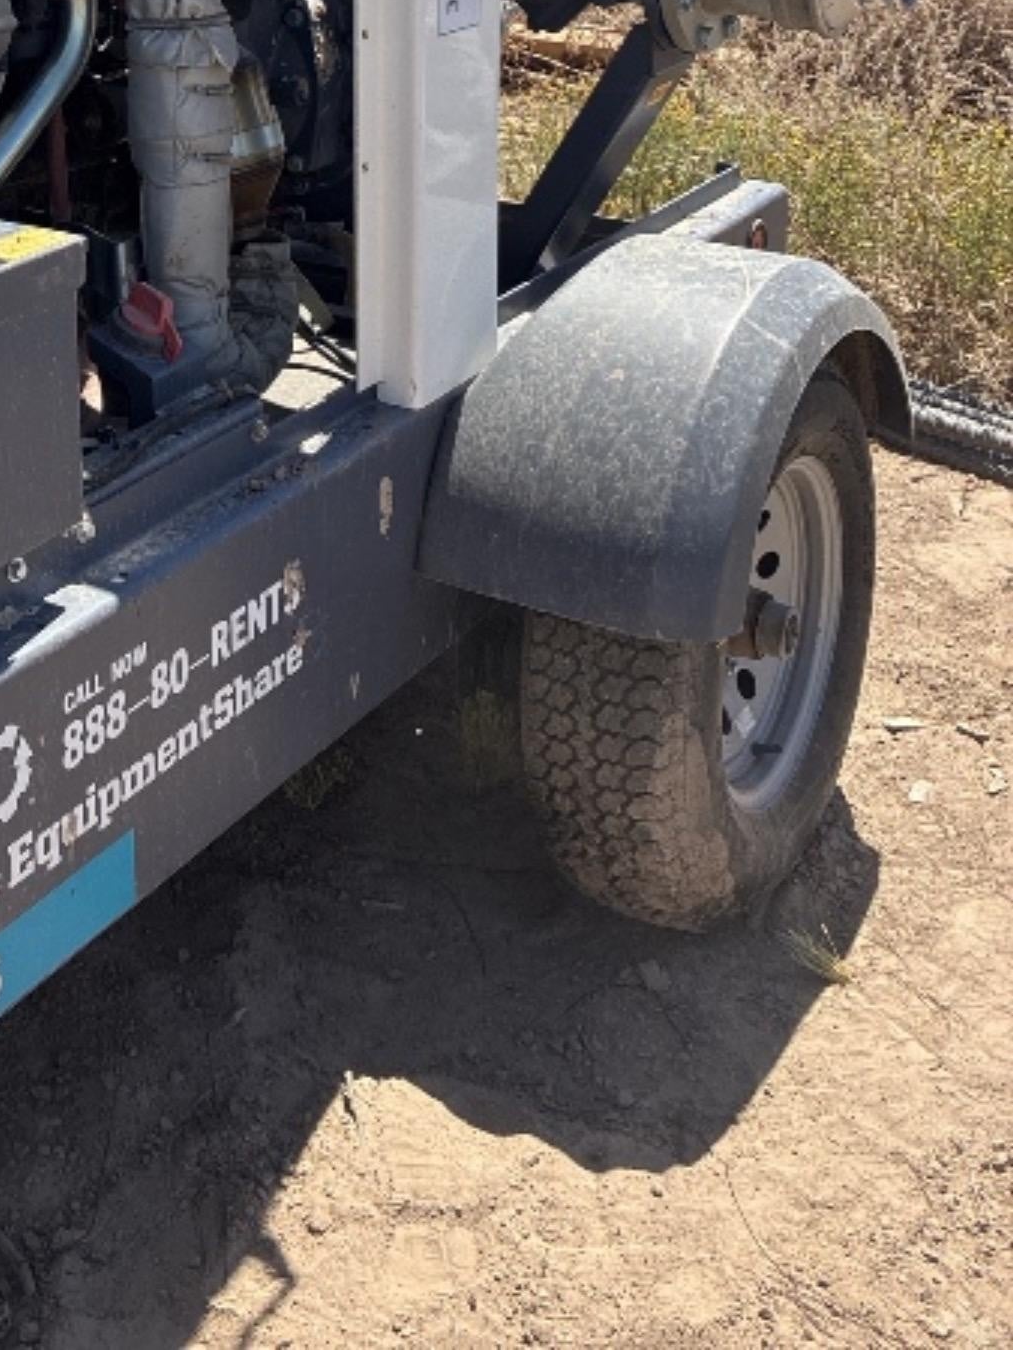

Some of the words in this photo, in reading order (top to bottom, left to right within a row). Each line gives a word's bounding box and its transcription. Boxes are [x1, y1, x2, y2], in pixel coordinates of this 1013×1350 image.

[64, 673, 105, 714] CALL
[110, 641, 148, 682] NOW
[7, 644, 304, 889] EquipmentShare
